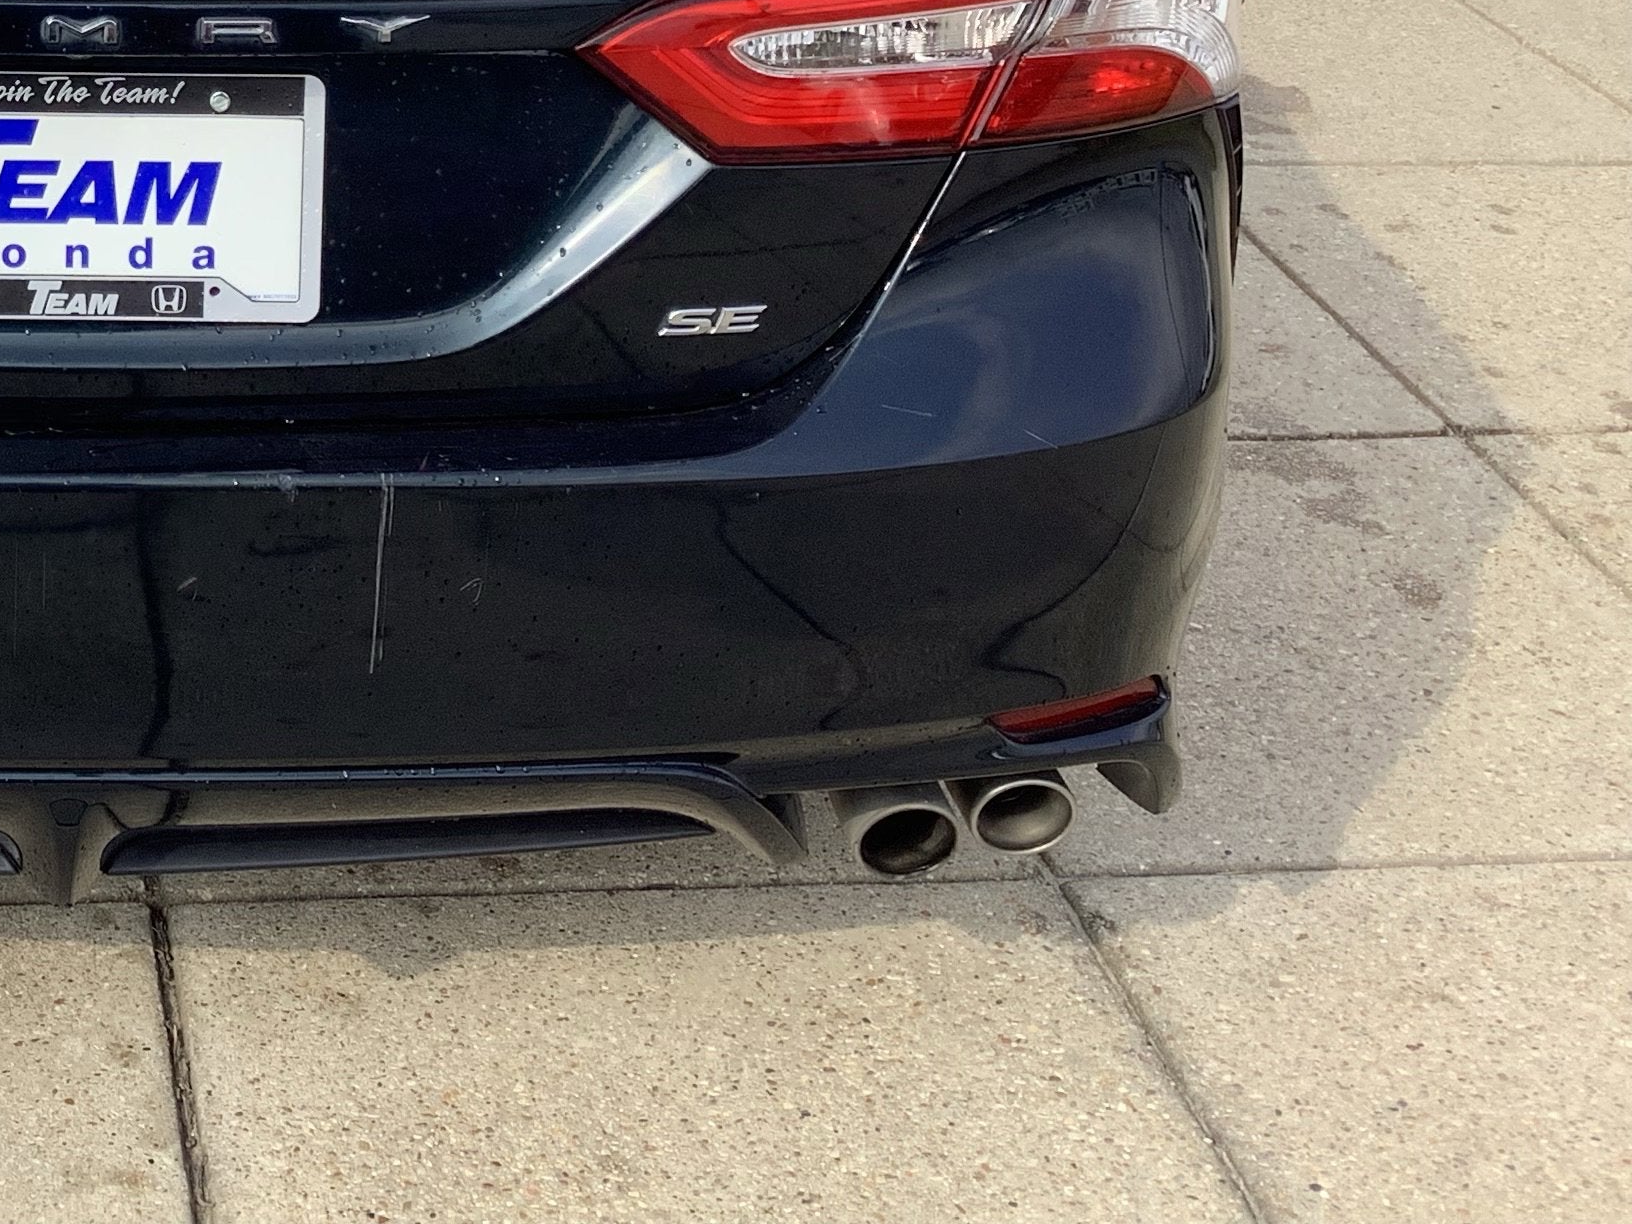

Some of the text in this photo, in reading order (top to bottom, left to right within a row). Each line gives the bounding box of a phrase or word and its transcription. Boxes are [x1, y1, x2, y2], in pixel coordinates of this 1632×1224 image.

[37, 76, 91, 105] The
[94, 76, 186, 105] Team!
[26, 280, 120, 316] TEAM
[657, 305, 768, 337] SE
